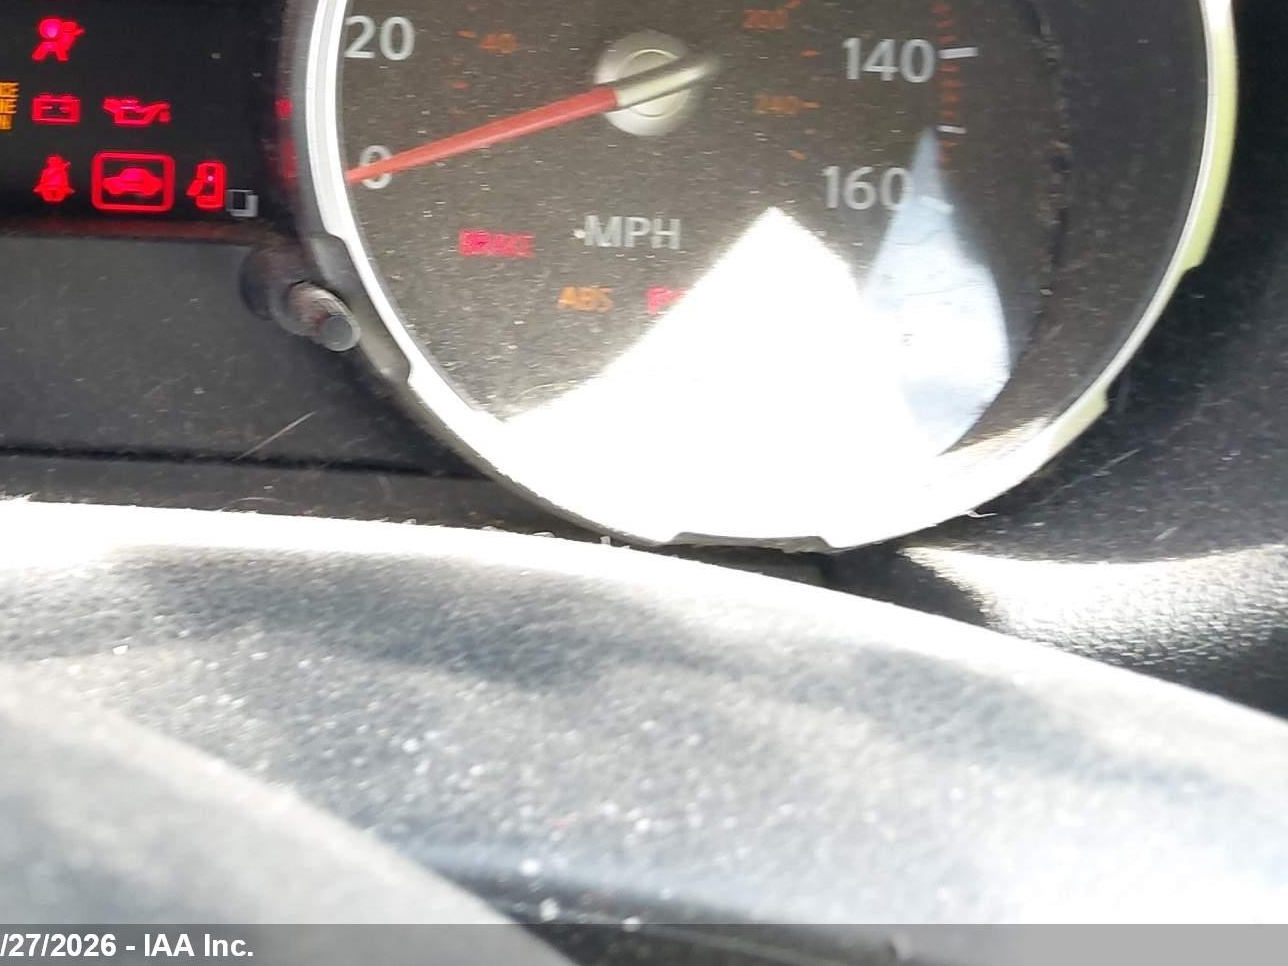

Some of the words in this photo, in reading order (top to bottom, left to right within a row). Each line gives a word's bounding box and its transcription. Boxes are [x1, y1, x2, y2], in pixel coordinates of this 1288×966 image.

[344, 15, 416, 61] 20
[842, 37, 936, 83] 140
[358, 144, 394, 190] 0
[820, 165, 912, 211] 160
[582, 214, 681, 250] MPH
[557, 285, 614, 313] ABS
